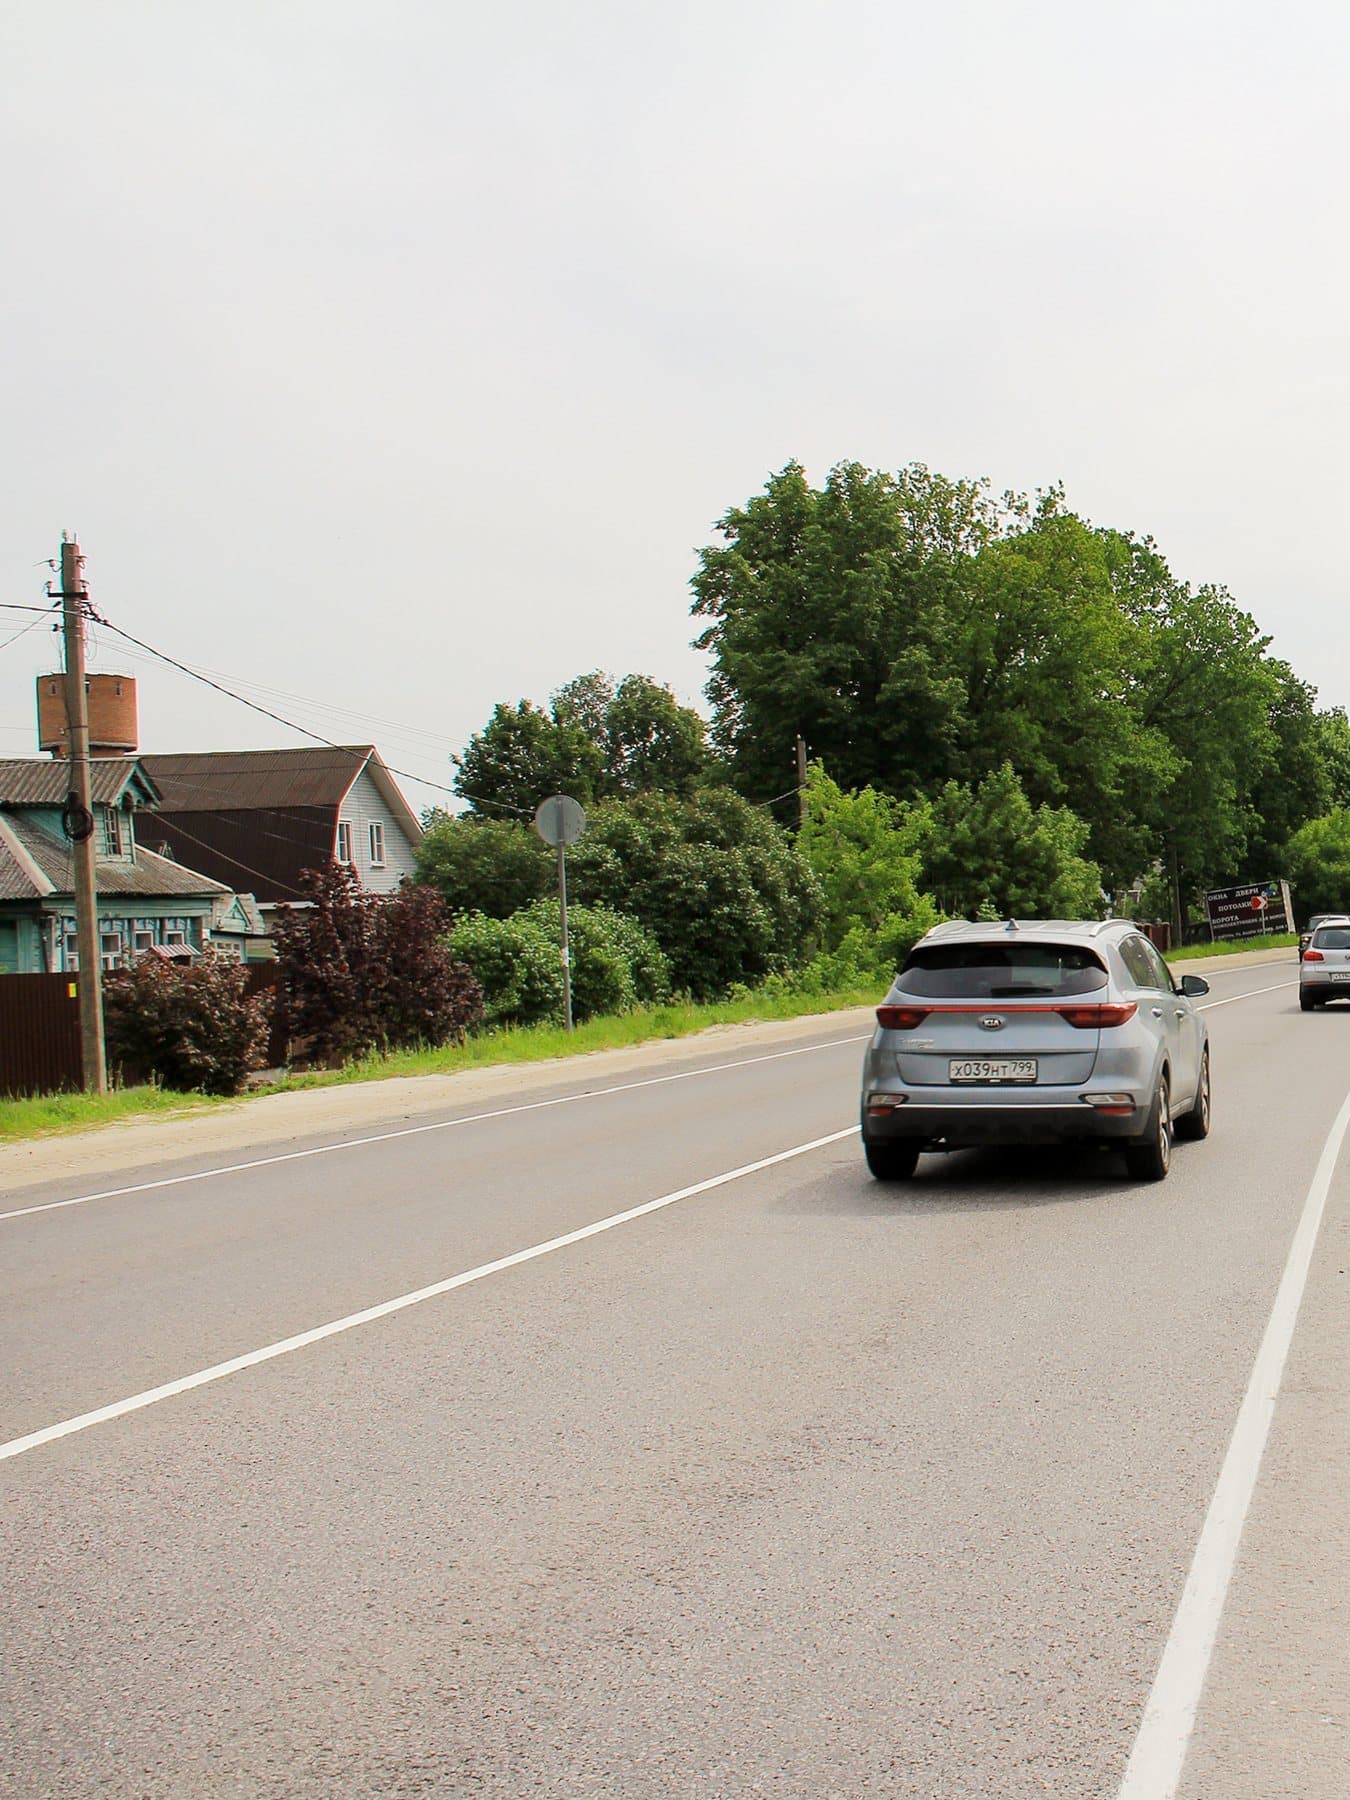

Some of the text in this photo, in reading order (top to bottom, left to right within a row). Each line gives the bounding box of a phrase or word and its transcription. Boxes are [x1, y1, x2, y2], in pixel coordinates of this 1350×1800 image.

[1208, 888, 1259, 902] ОКНА ДВЕРИ
[1212, 915, 1240, 924] ВОРОТА
